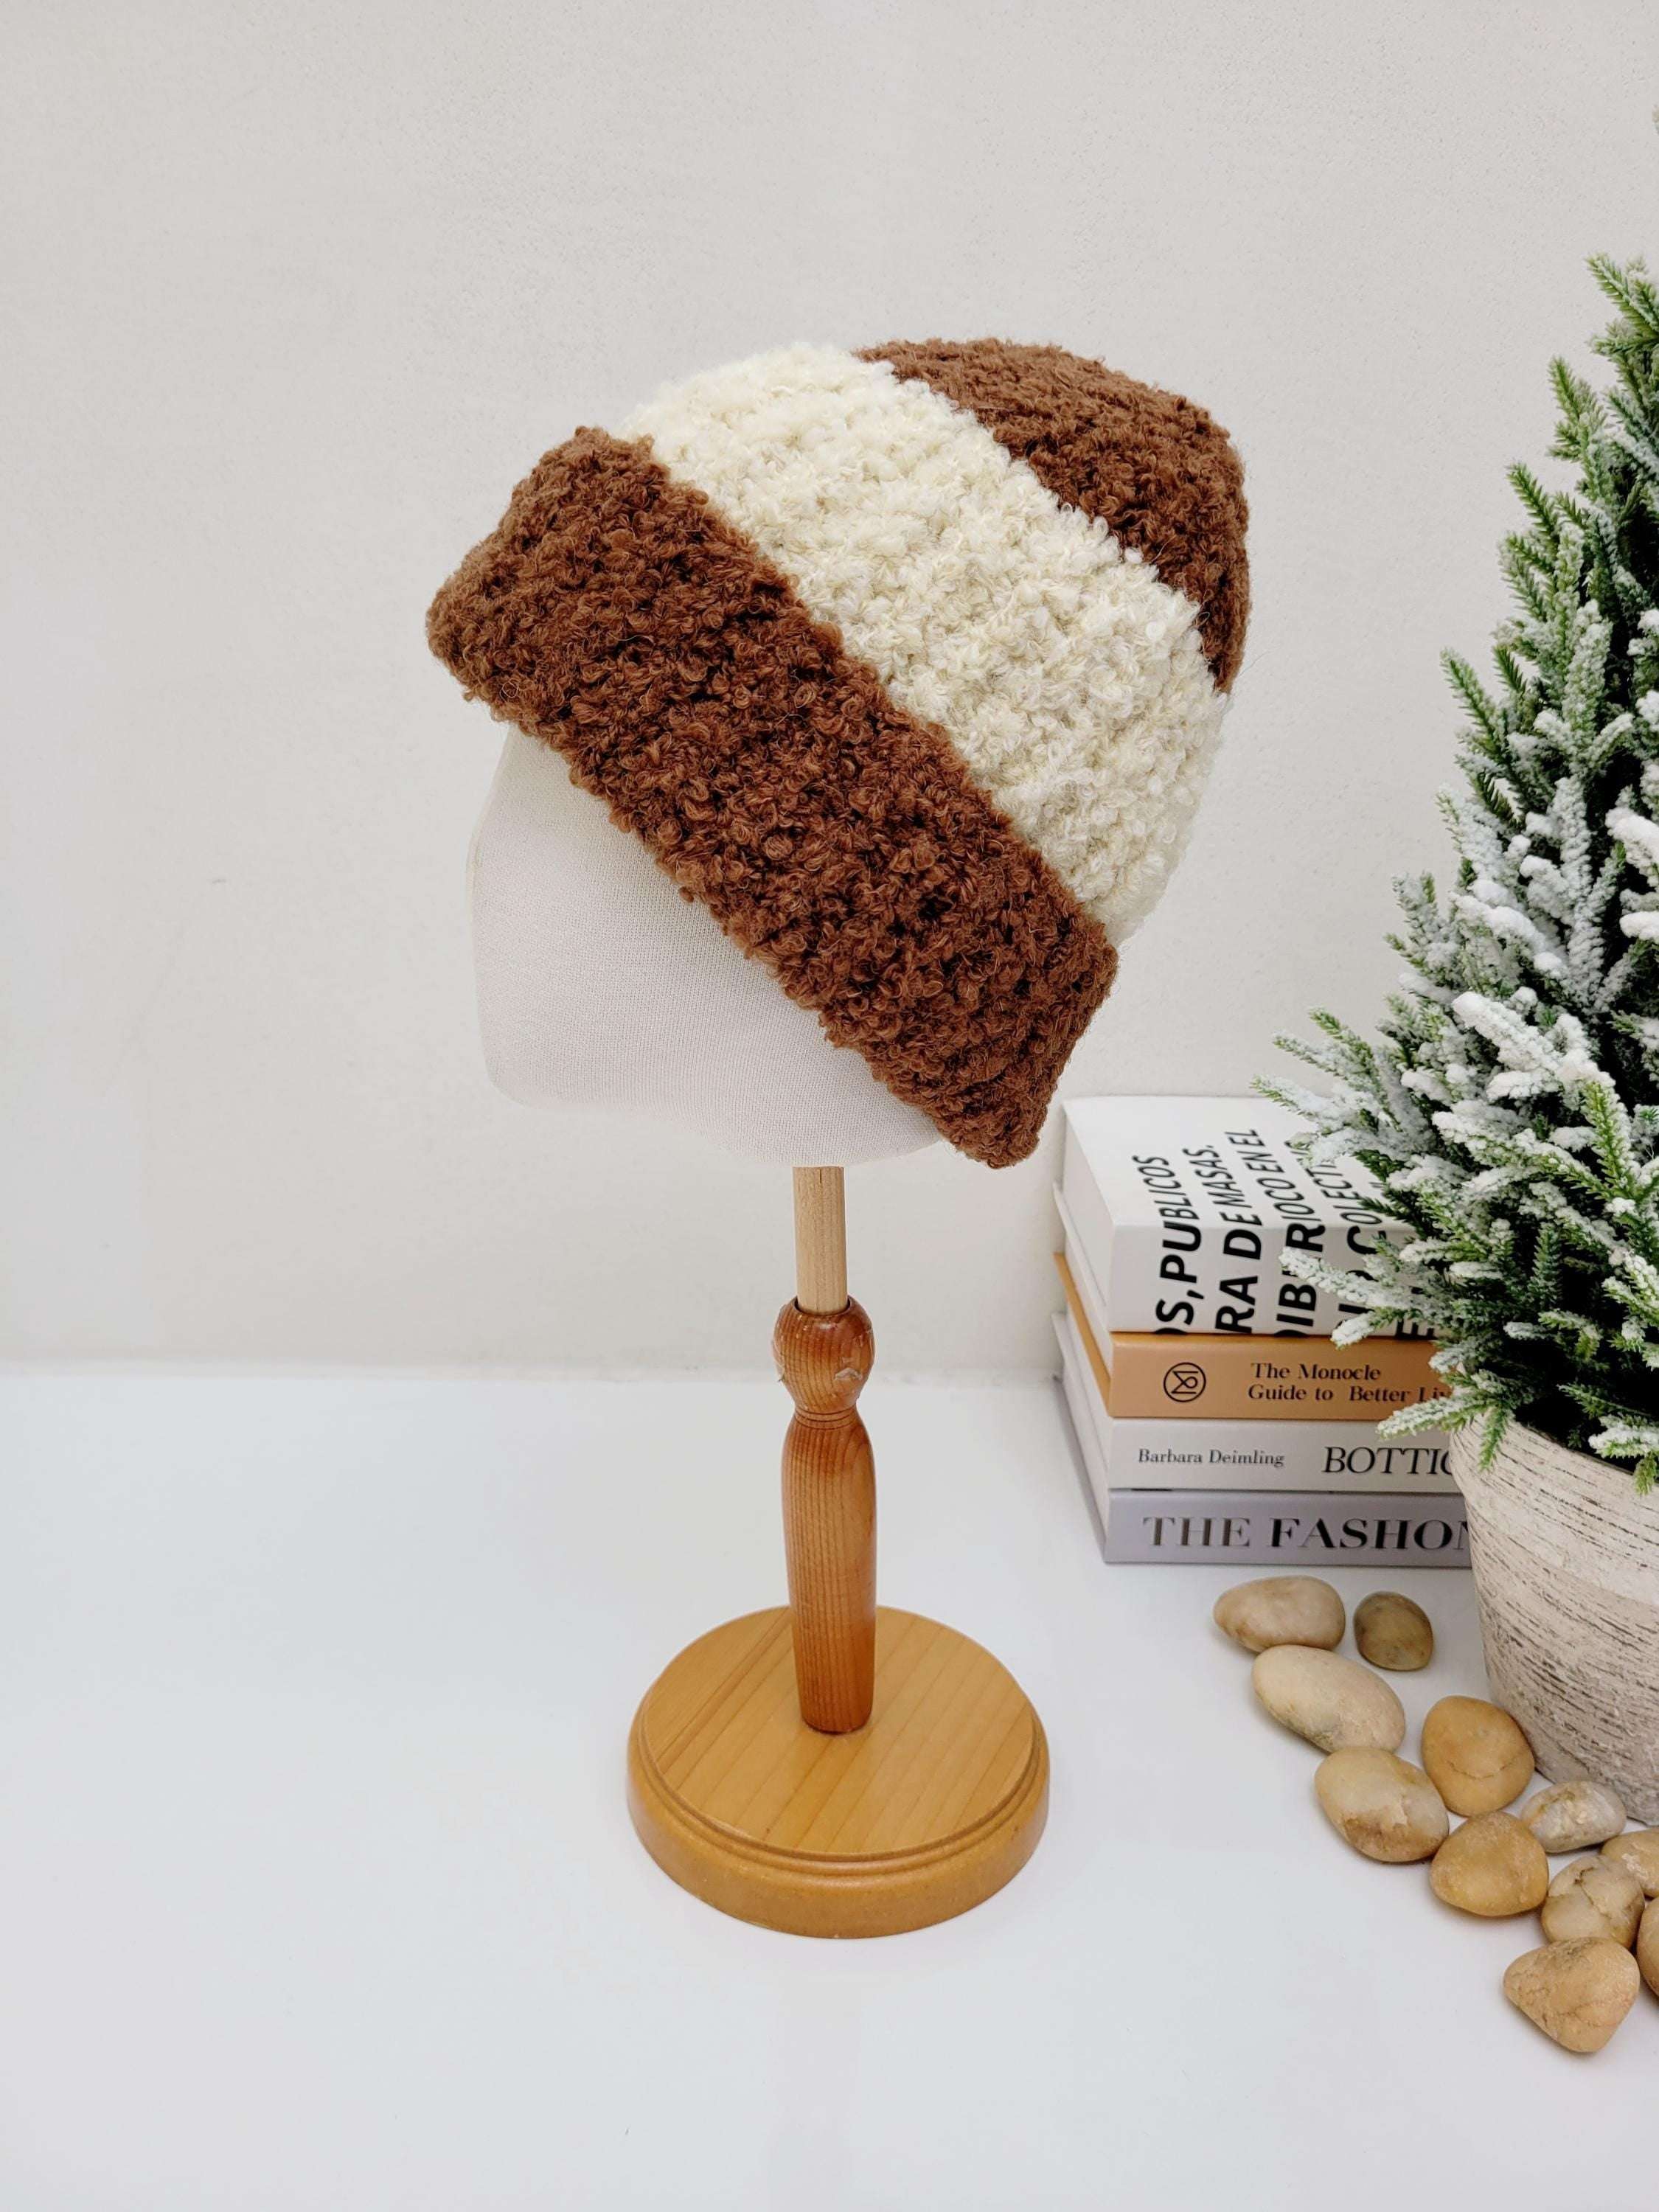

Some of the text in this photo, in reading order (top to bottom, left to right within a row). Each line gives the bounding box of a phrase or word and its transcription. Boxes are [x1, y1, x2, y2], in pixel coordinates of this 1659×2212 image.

[1224, 1129, 1266, 1147] EL
[1237, 1150, 1285, 1173] EN
[1182, 1144, 1252, 1208] MASAS.
[1132, 1155, 1205, 1336] S, PUBLICOS
[1219, 1212, 1262, 1260] DE
[1251, 1363, 1381, 1380] The Monocle
[1248, 1384, 1307, 1400] Guide
[1315, 1387, 1334, 1400] to
[1349, 1385, 1409, 1402] Better
[1138, 1448, 1203, 1463] Barbara
[1209, 1449, 1285, 1468] Deimling
[1143, 1517, 1251, 1548] THE
